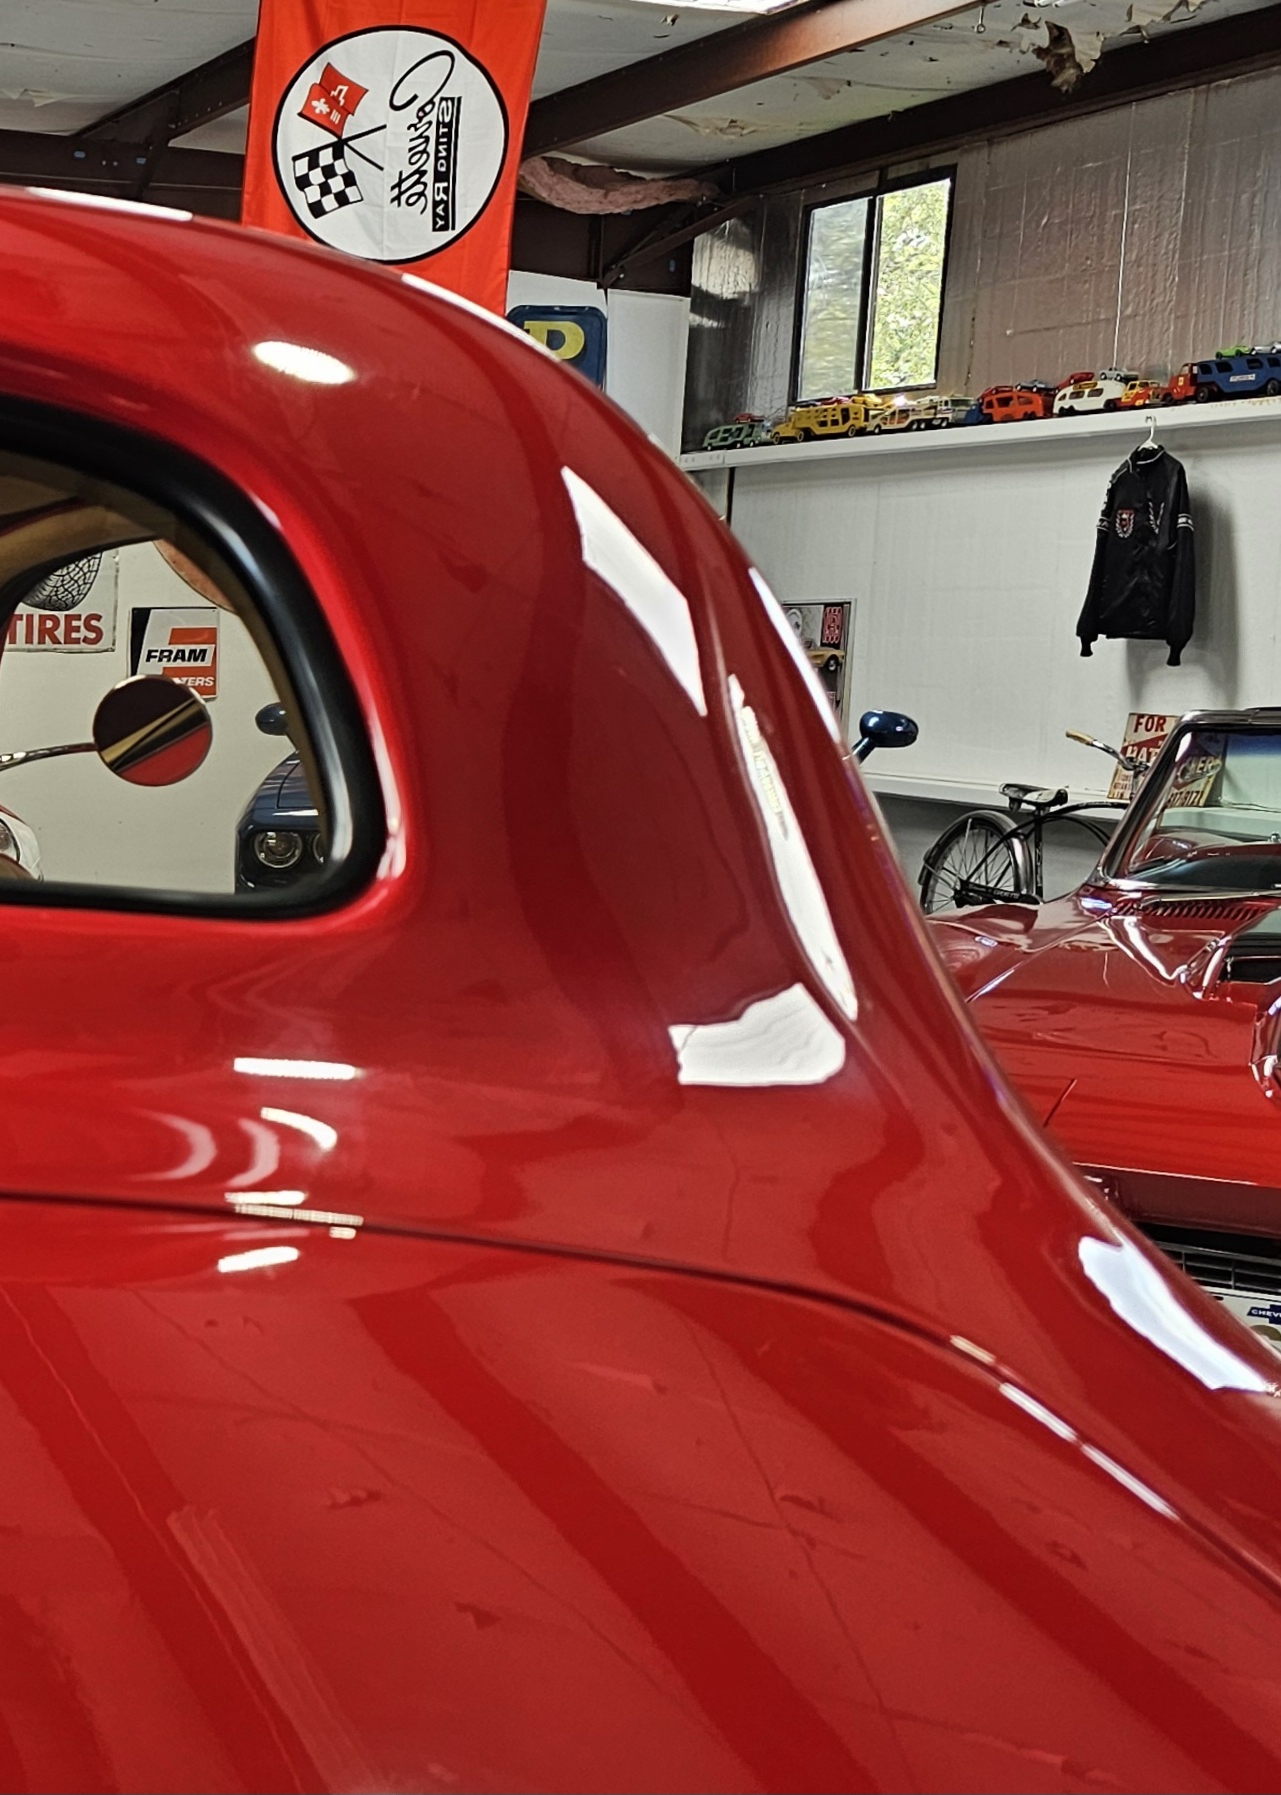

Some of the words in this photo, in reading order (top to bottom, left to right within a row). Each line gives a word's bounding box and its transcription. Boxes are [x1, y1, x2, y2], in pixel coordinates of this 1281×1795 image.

[7, 612, 104, 646] TIRES
[145, 648, 208, 664] FRAM
[1133, 714, 1168, 734] FOR
[1251, 1308, 1281, 1319] CHEV
